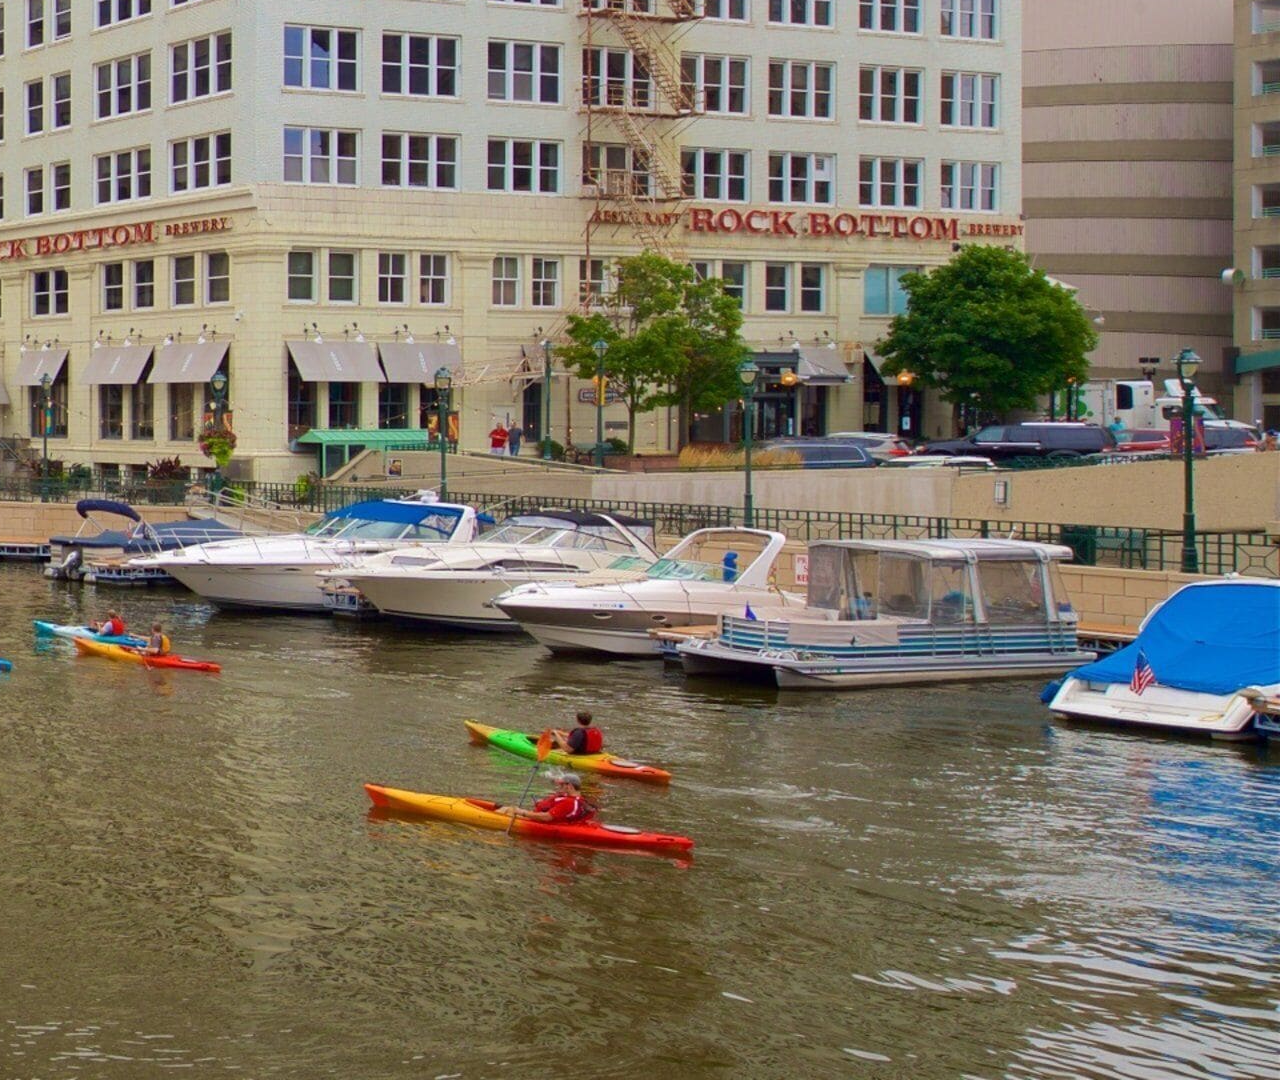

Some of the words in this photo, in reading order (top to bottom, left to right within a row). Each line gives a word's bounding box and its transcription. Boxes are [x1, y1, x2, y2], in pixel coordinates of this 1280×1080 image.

[35, 221, 157, 256] BOTTOM
[165, 217, 228, 236] BREWERY
[689, 208, 797, 237] ROCK
[808, 212, 961, 241] BOTTOM
[968, 223, 1024, 236] BREWERY
